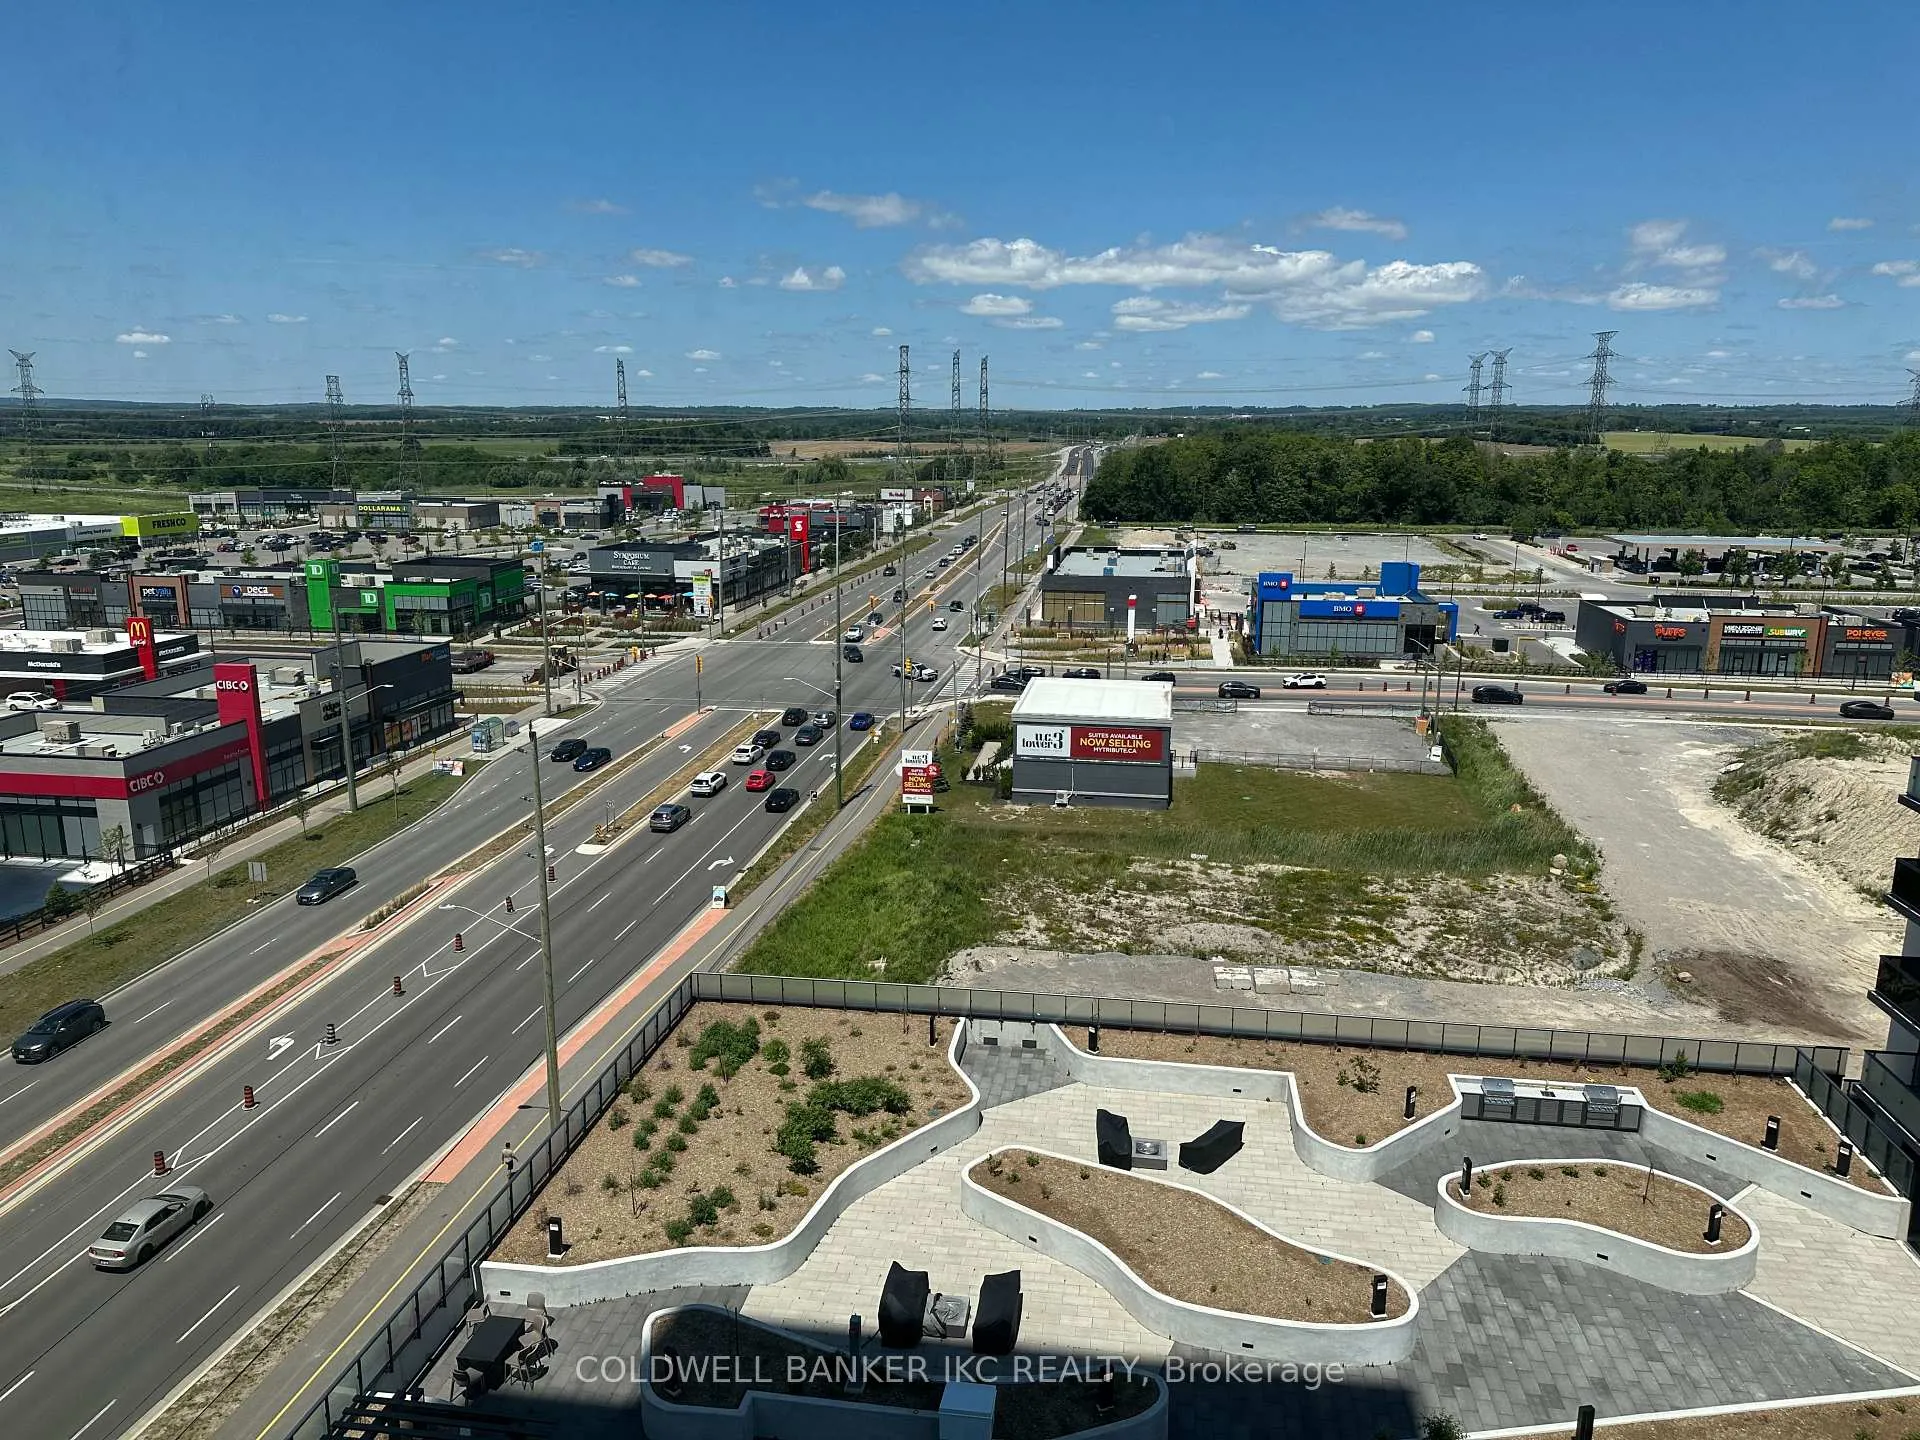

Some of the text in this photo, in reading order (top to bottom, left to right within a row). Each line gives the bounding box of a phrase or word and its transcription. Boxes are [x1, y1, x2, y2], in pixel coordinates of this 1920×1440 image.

[308, 564, 323, 576] TD
[362, 593, 376, 603] TD
[1768, 628, 1806, 637] SUBWAY
[216, 680, 239, 690] CIBC
[1022, 738, 1053, 748] tower
[1080, 738, 1151, 749] NOW SELLING
[129, 774, 155, 792] CIBC
